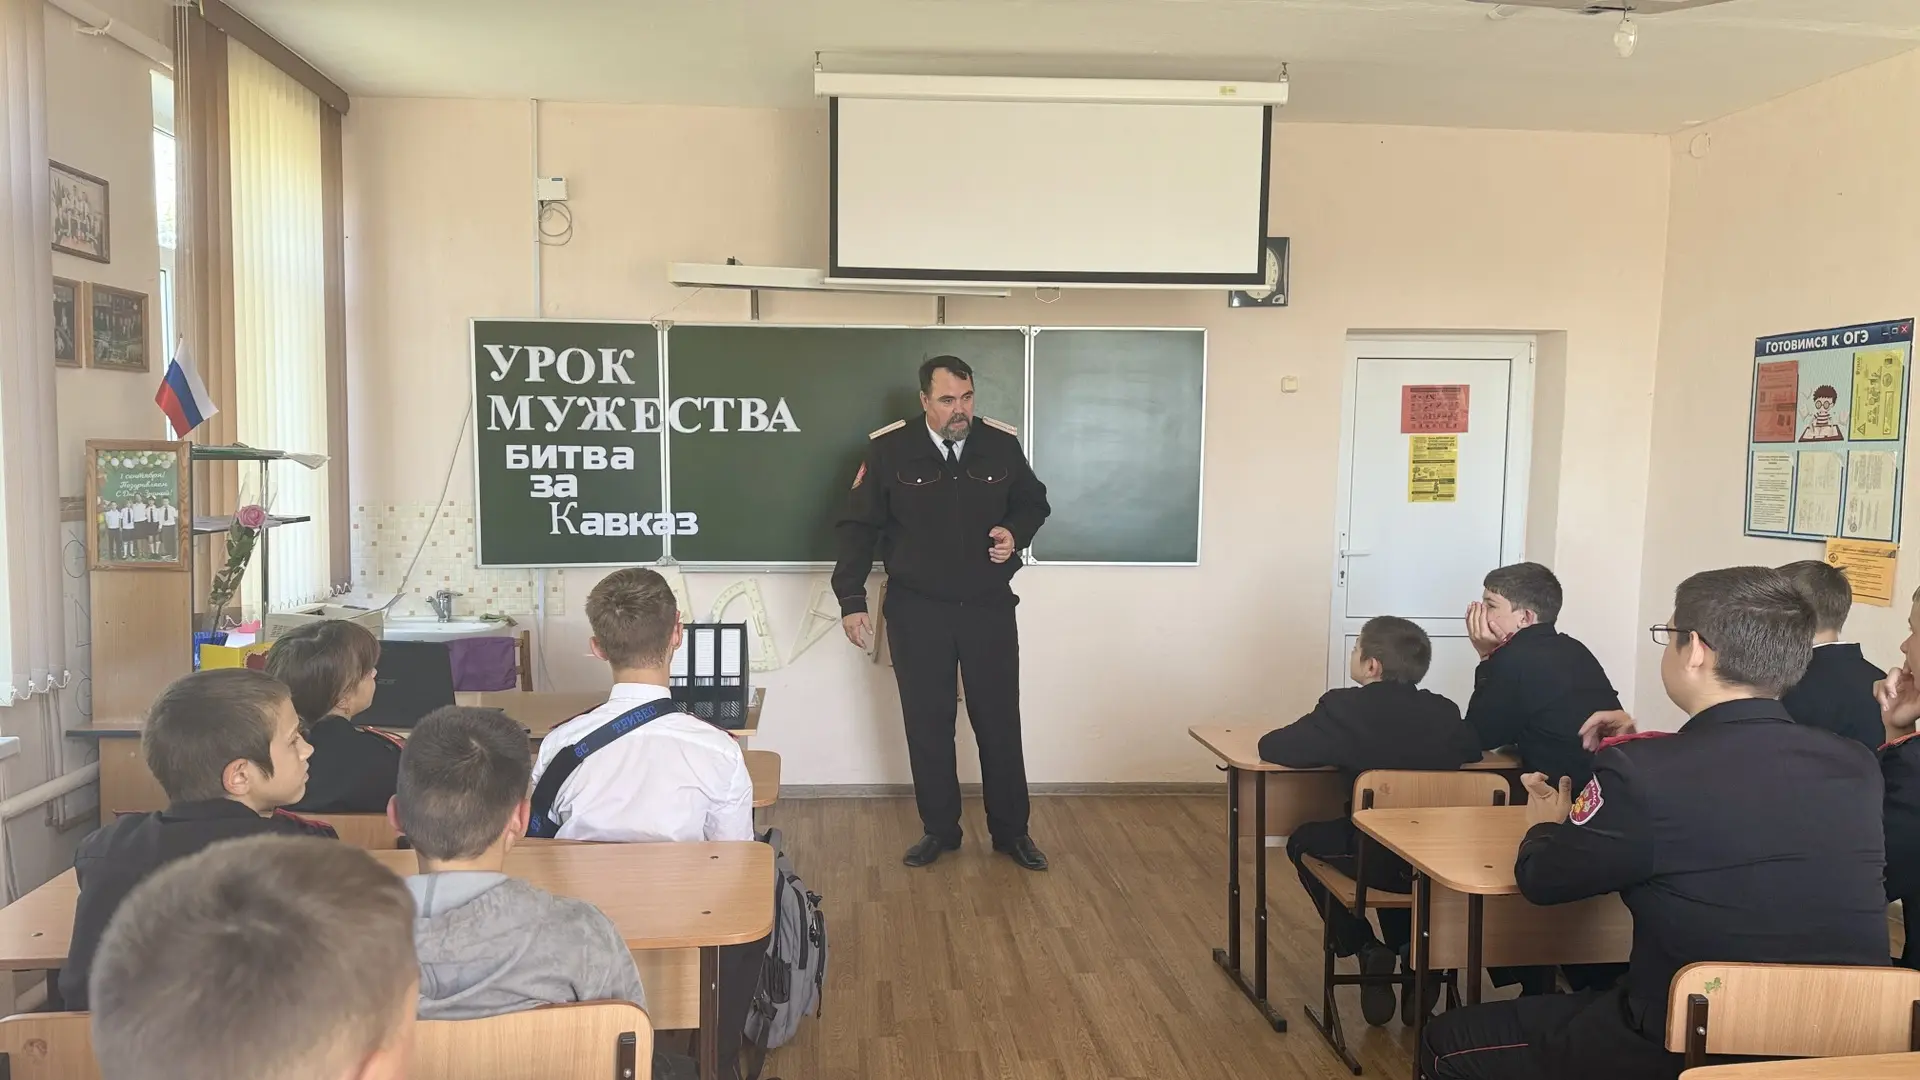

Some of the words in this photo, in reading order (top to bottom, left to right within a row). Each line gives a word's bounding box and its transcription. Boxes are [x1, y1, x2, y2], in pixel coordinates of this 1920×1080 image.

[1765, 335, 1828, 353] ГОТОВИМСЯ
[1843, 329, 1869, 345] ОГЭ
[482, 344, 636, 385] УРОК
[486, 394, 801, 433] МУЖЕСТВА
[530, 473, 578, 498] за
[549, 501, 699, 536] Кавказ
